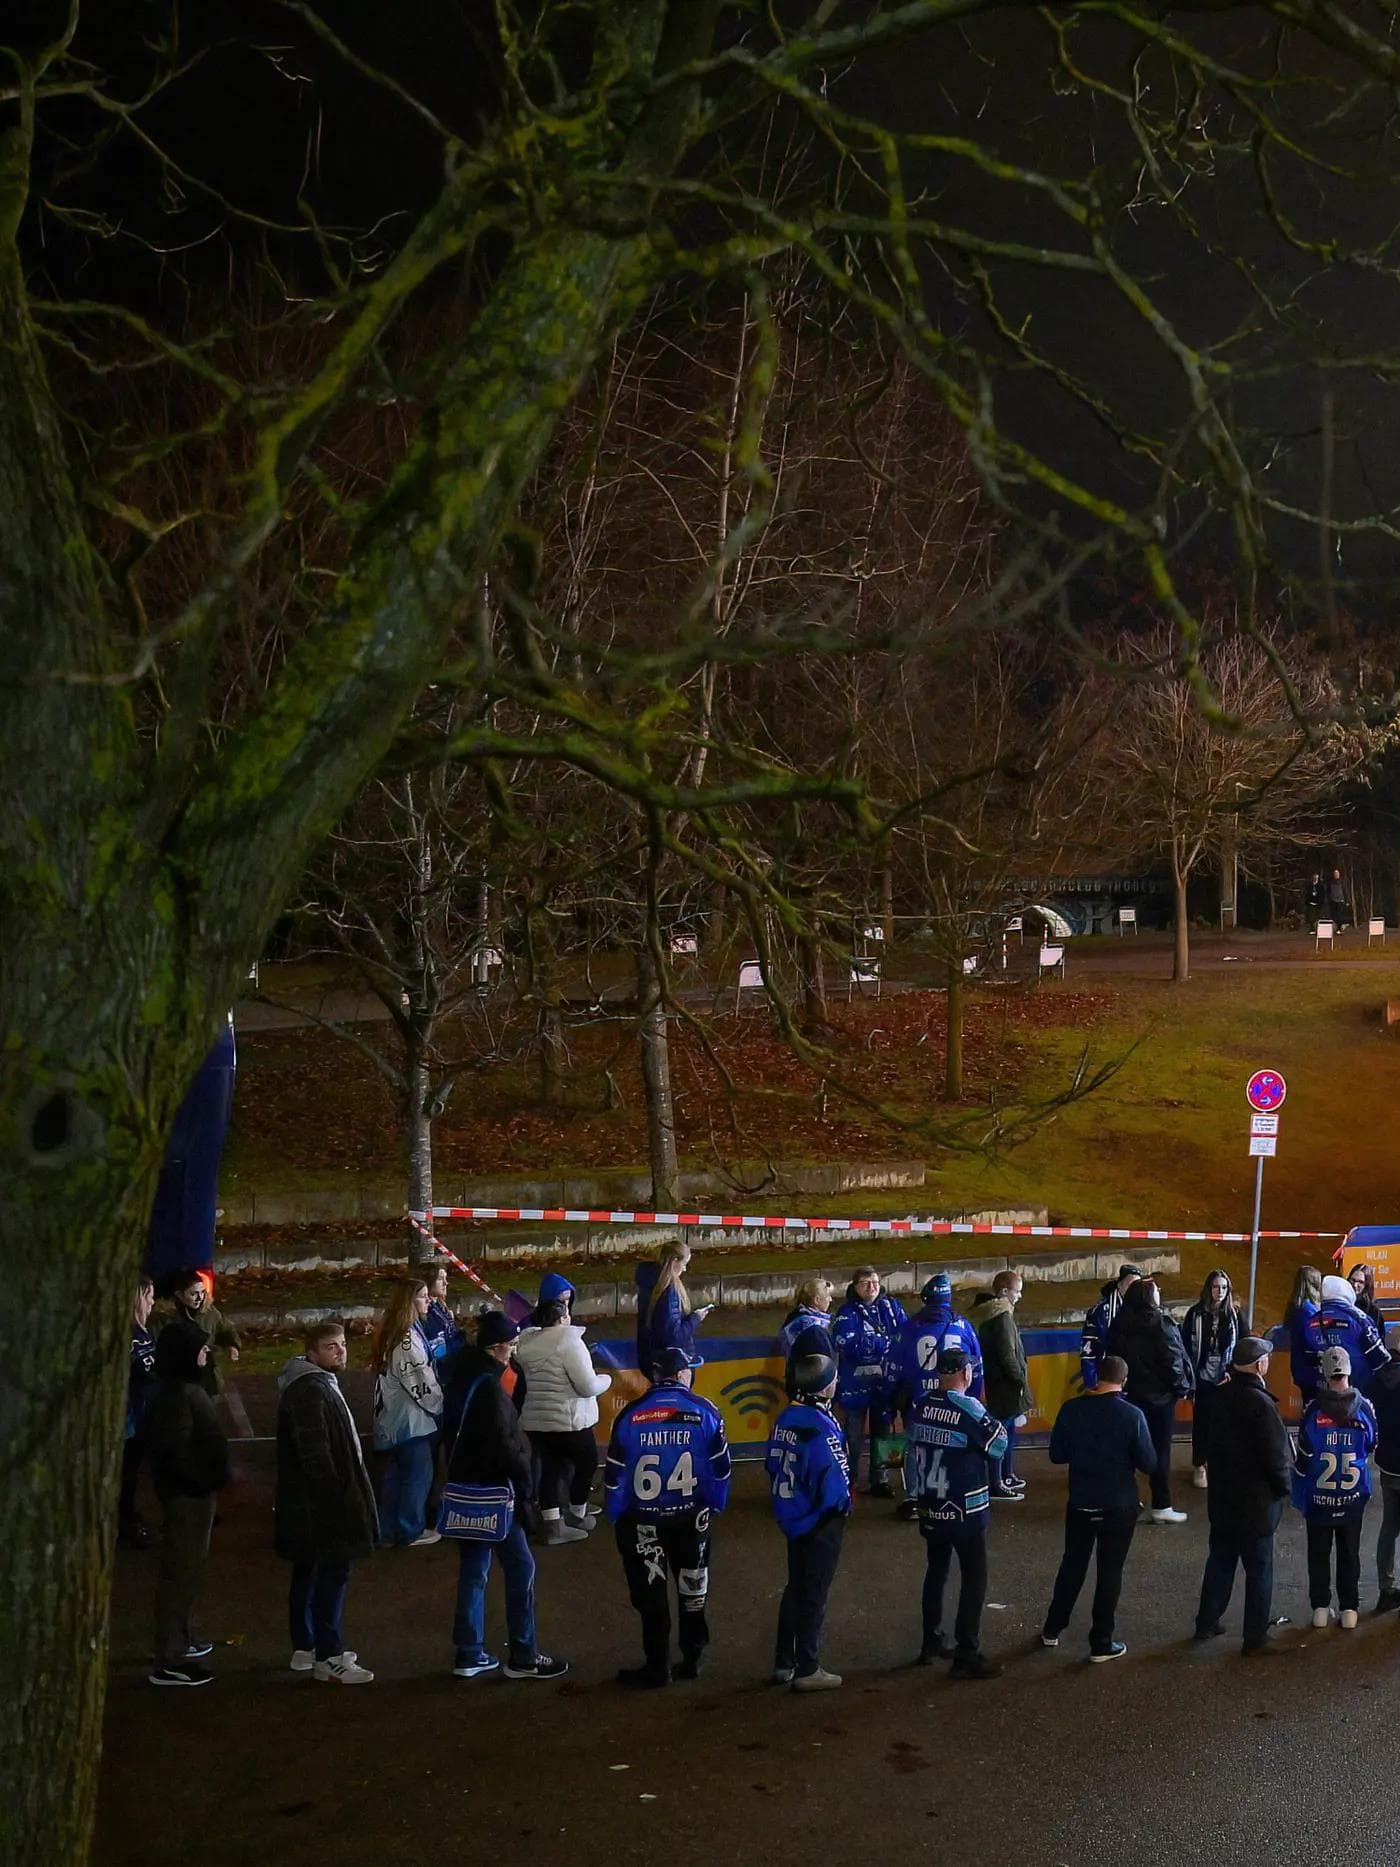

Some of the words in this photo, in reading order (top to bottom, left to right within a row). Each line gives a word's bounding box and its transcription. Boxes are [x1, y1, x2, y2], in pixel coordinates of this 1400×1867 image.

[922, 1406, 961, 1425] SATURN
[641, 1430, 691, 1446] PANTHER
[634, 1451, 699, 1500] 64
[1317, 1452, 1360, 1490] 25
